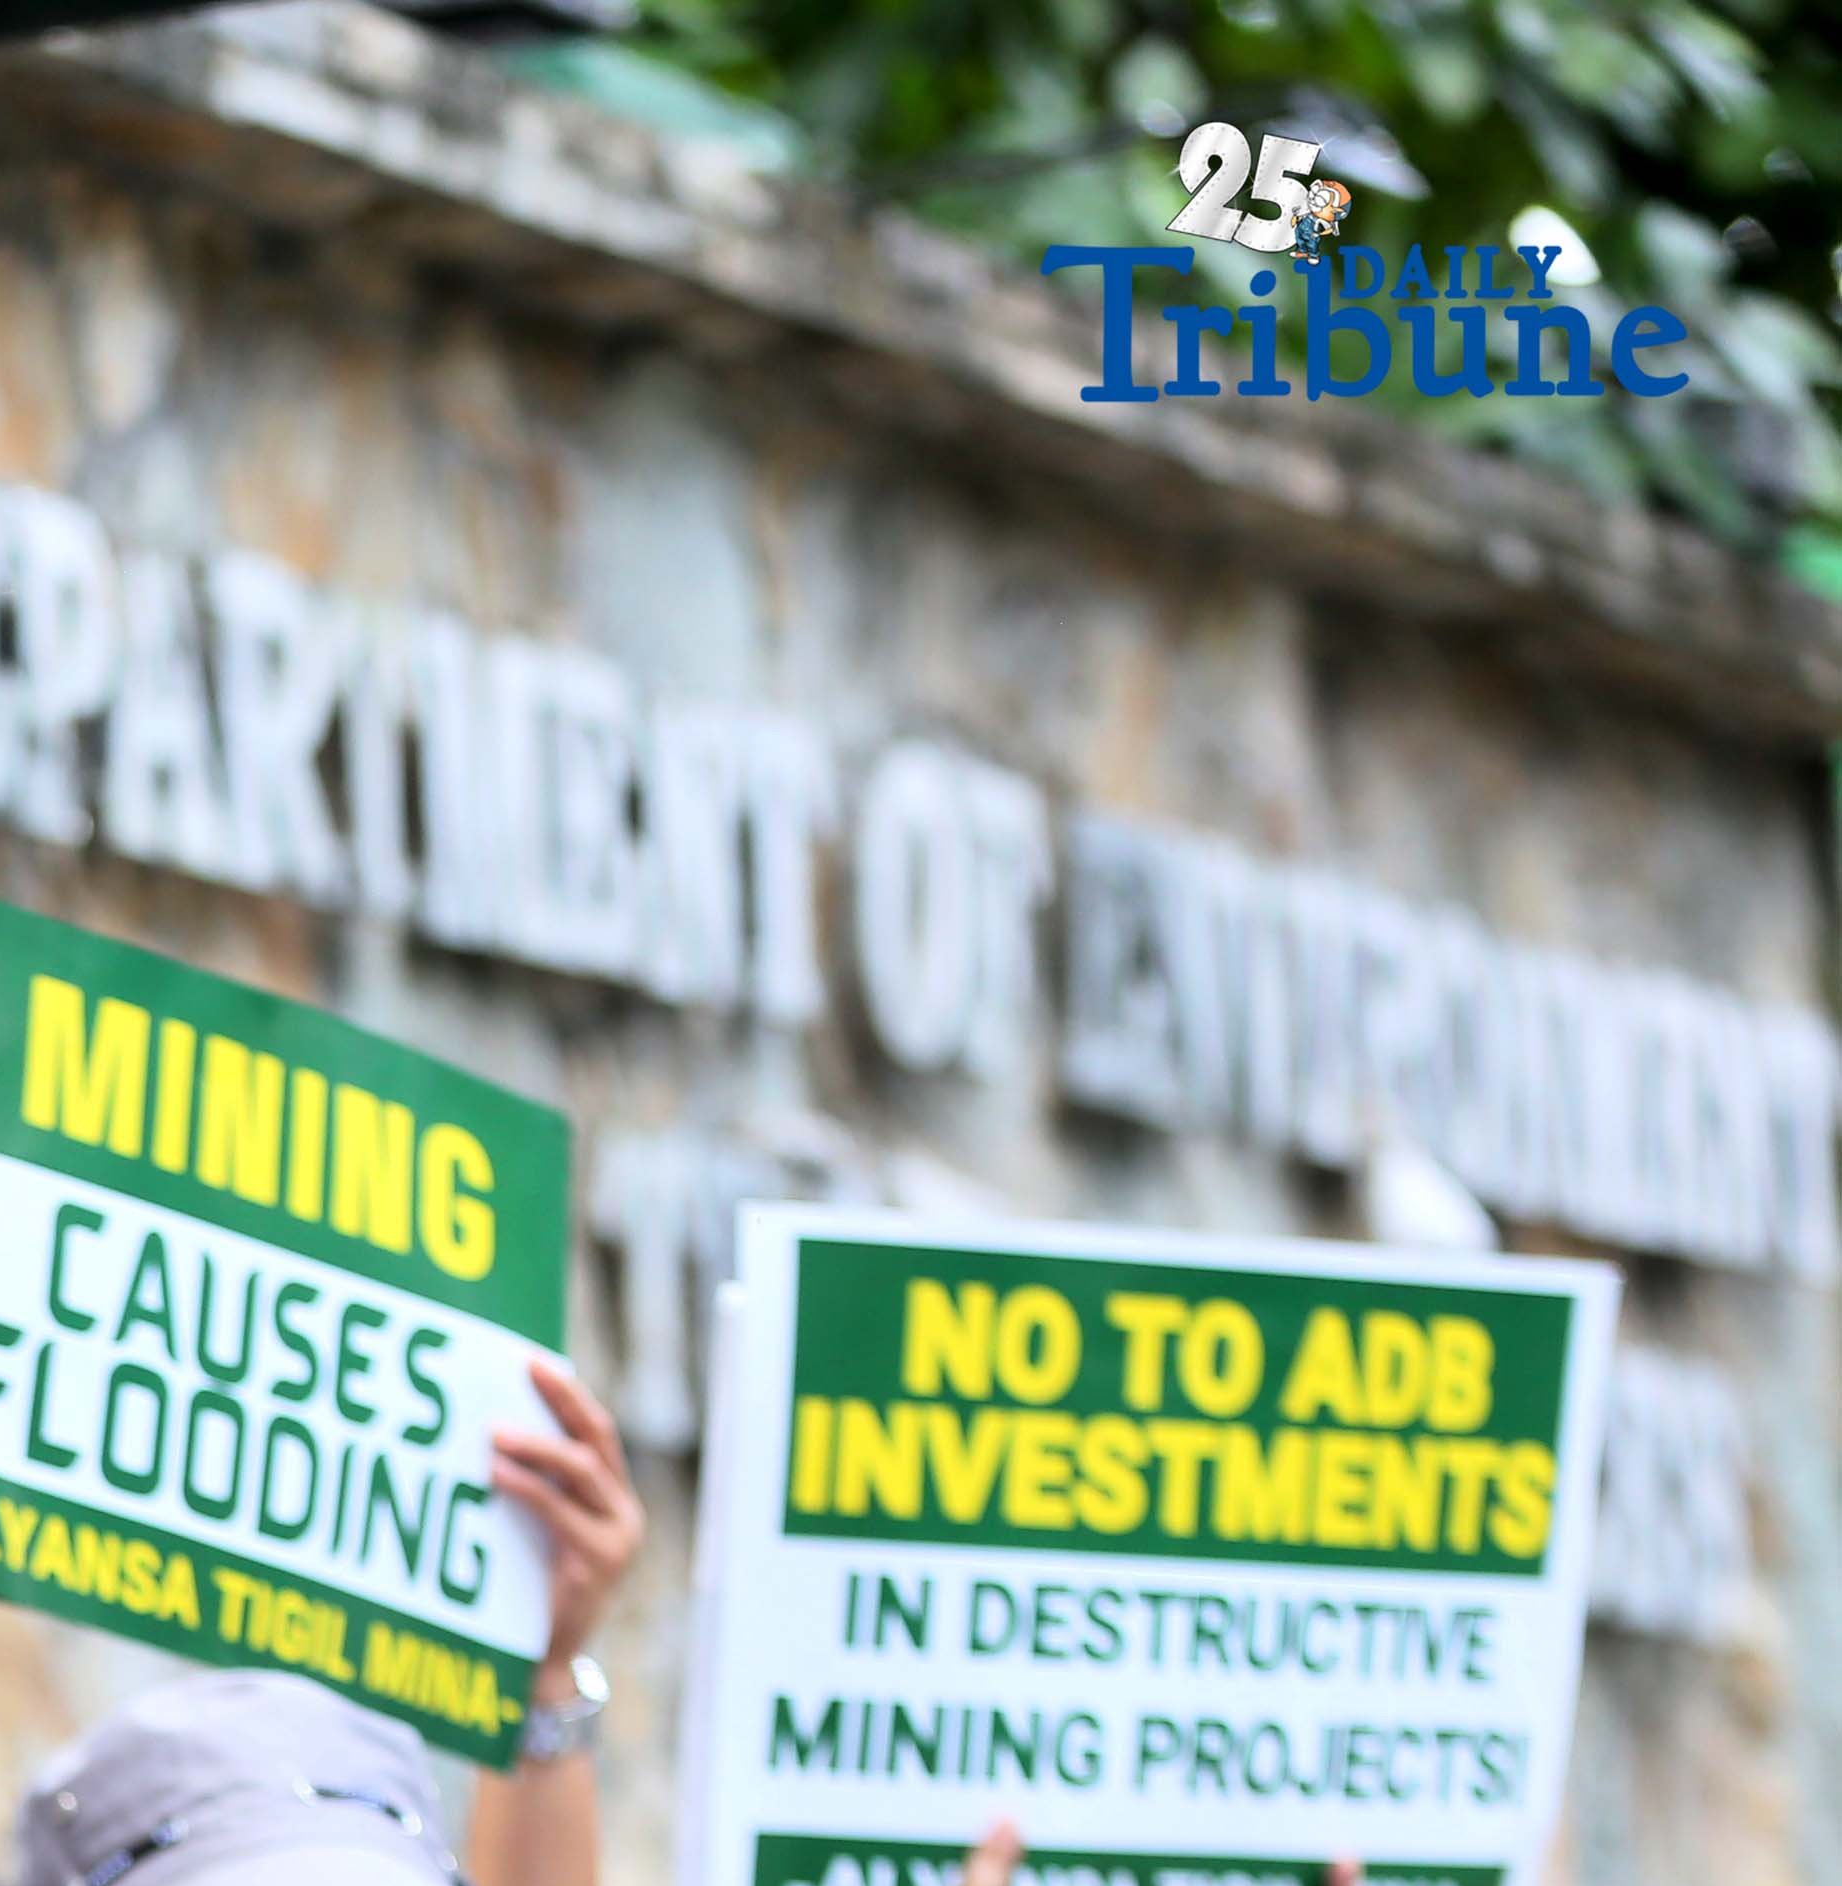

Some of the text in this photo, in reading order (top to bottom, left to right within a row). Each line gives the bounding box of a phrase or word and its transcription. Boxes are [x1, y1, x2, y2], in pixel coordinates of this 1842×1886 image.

[851, 735, 1052, 1073] OF
[21, 973, 497, 1280] MINING
[48, 1204, 457, 1446] CAUSES
[902, 1278, 1497, 1430] NO TO ADB
[789, 1397, 1559, 1558] INVESTMENTS
[211, 1566, 356, 1682] TIGIL
[842, 1573, 1498, 1682] IN DESTRUCTIVE
[766, 1694, 1104, 1788] MINING
